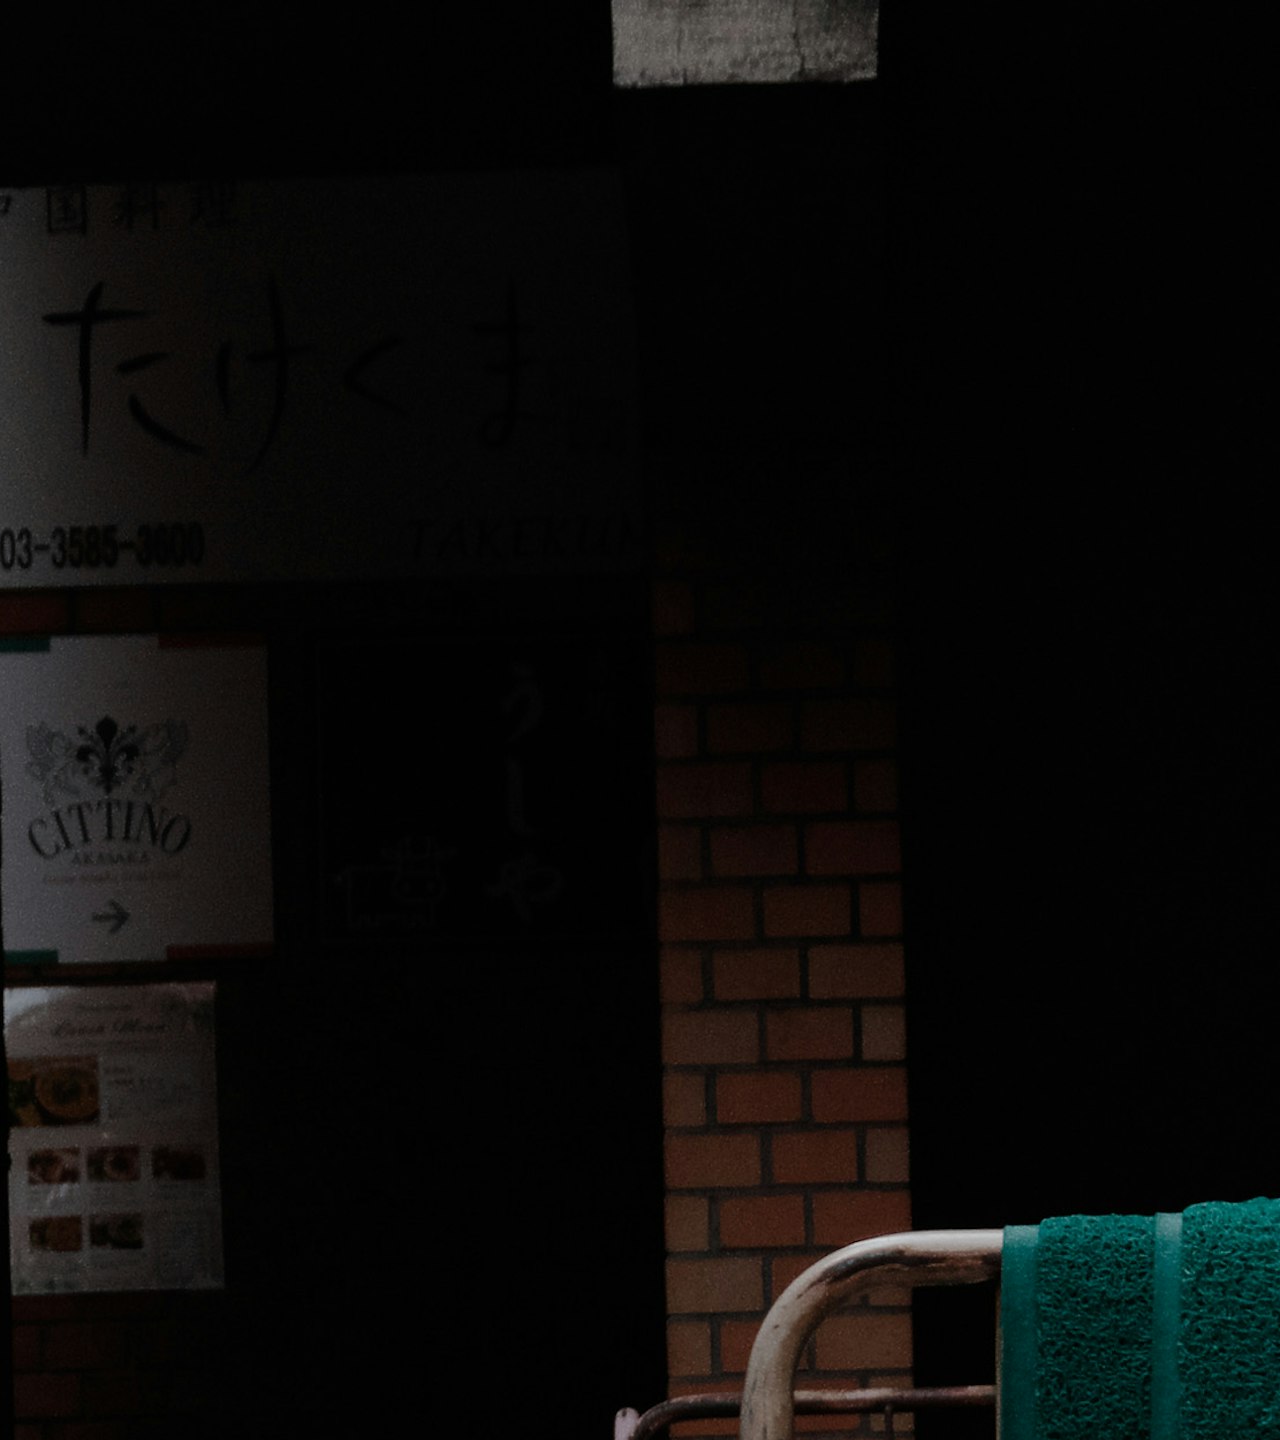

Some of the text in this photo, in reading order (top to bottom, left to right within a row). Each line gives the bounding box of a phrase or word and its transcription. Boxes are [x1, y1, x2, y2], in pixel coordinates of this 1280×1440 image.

[43, 278, 552, 477] たけくま
[28, 798, 192, 860] CITTINO
[483, 660, 566, 925] うしや
